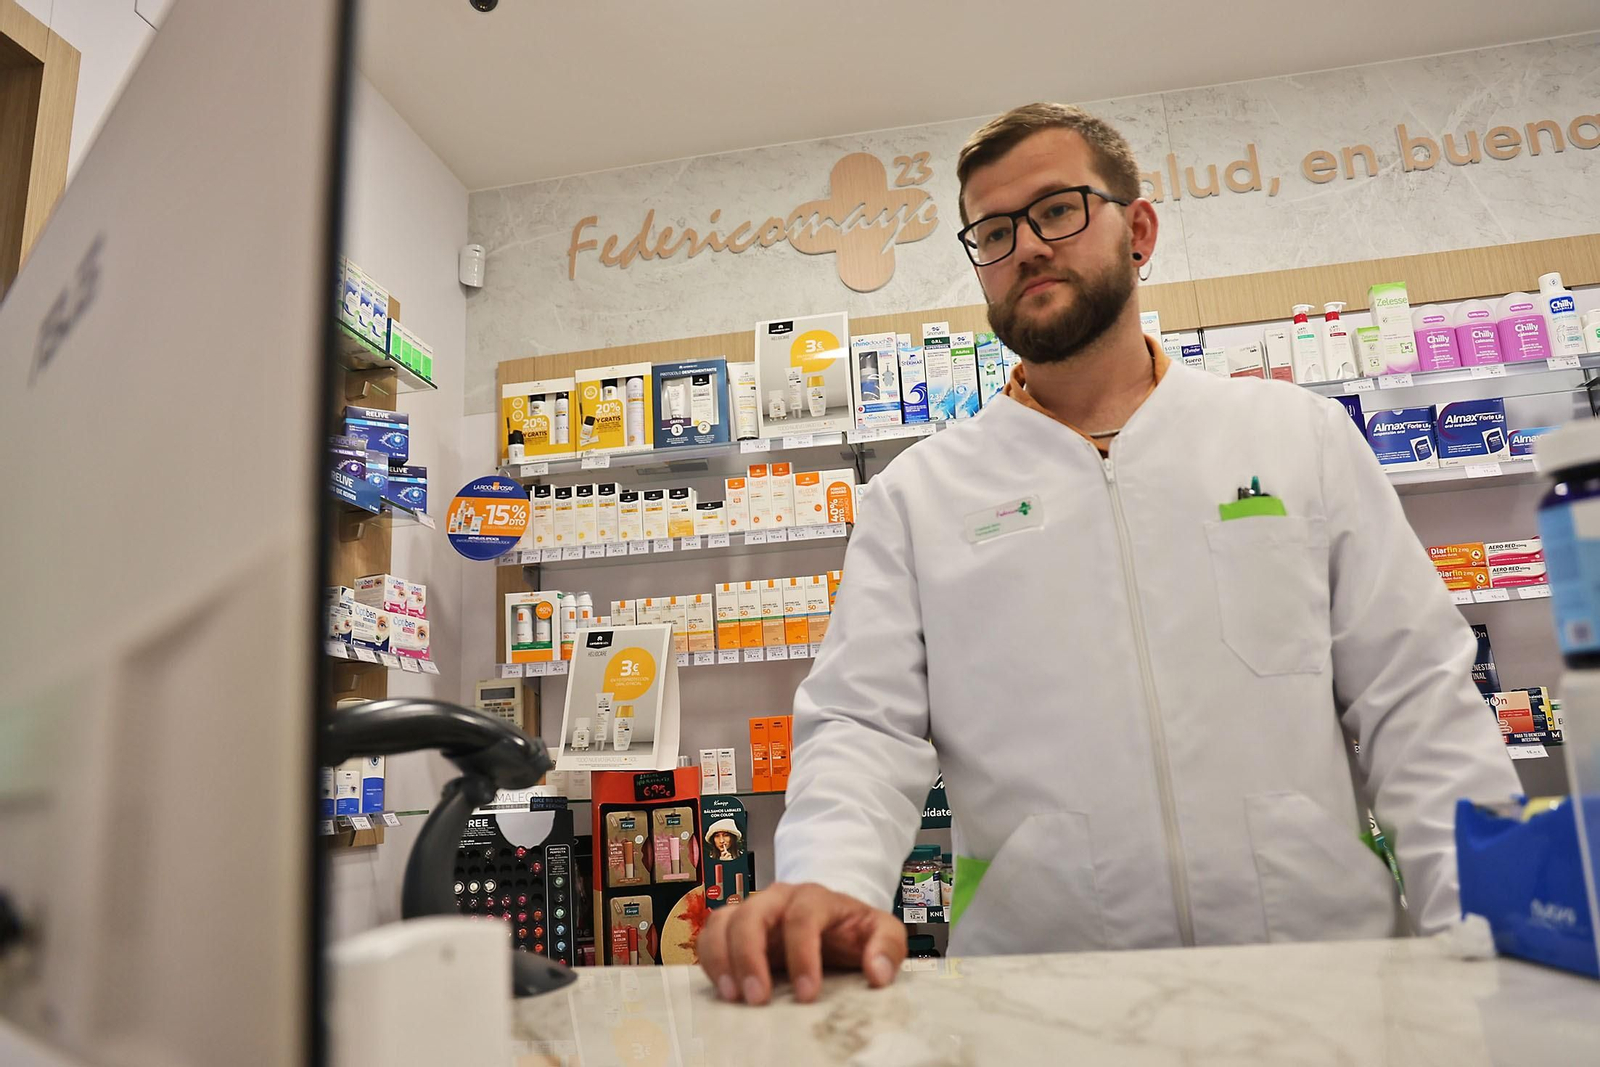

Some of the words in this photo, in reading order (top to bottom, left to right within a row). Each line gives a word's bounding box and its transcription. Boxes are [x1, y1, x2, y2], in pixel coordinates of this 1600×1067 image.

[893, 150, 933, 187] 23
[1139, 143, 1279, 204] alud,
[1301, 143, 1378, 184] en
[1376, 297, 1408, 307] Zelesse
[1550, 299, 1574, 310] Chilly
[1514, 323, 1538, 332] Chilly
[1426, 334, 1450, 344] Chilly
[1472, 330, 1495, 339] Chilly
[595, 403, 620, 414] 20%
[365, 410, 390, 419] RELIVE
[1445, 414, 1476, 424] Almax
[523, 418, 547, 429] 20%
[1374, 423, 1404, 432] Almax
[482, 504, 526, 525] -15%
[830, 498, 839, 522] 40%
[1431, 546, 1458, 555] Diarfin
[356, 605, 376, 618] Optiben
[922, 808, 952, 817] uídate
[468, 818, 489, 827] REE
